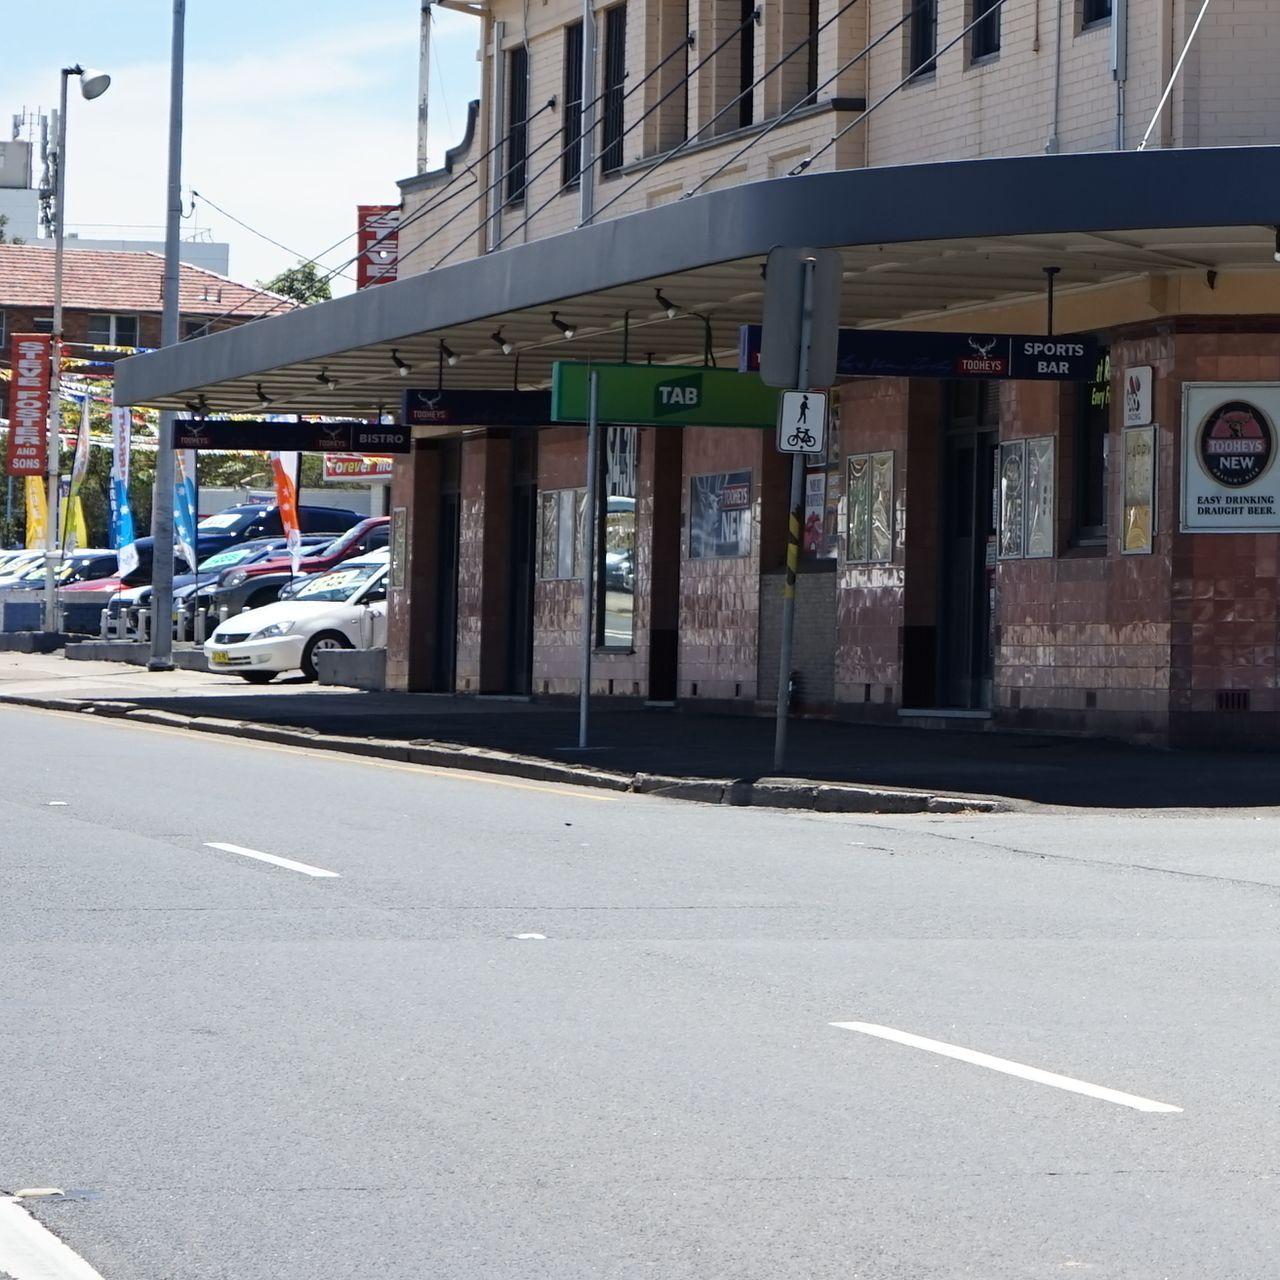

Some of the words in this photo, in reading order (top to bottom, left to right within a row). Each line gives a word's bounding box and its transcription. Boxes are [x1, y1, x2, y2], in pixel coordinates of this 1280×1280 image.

[1023, 342, 1085, 357] SPORTS
[17, 341, 45, 387] STEVE
[962, 359, 1002, 371] TOOHEYS
[1037, 360, 1070, 375] BAR
[659, 386, 698, 405] TAB
[14, 390, 42, 445] FOSTER
[413, 410, 446, 419] TOOHEYS
[181, 437, 209, 445] TOOHEYS
[319, 439, 346, 448] TOOHEYS
[359, 433, 404, 445] BISTRO
[16, 447, 37, 455] AND
[1208, 439, 1263, 452] TOOHEYS
[12, 458, 40, 469] SONS
[1219, 456, 1255, 470] NEW
[1197, 495, 1222, 505] EASY
[1225, 495, 1274, 505] DRINKING
[1197, 506, 1244, 516] DRAUGHT
[1247, 506, 1276, 516] BEER.
